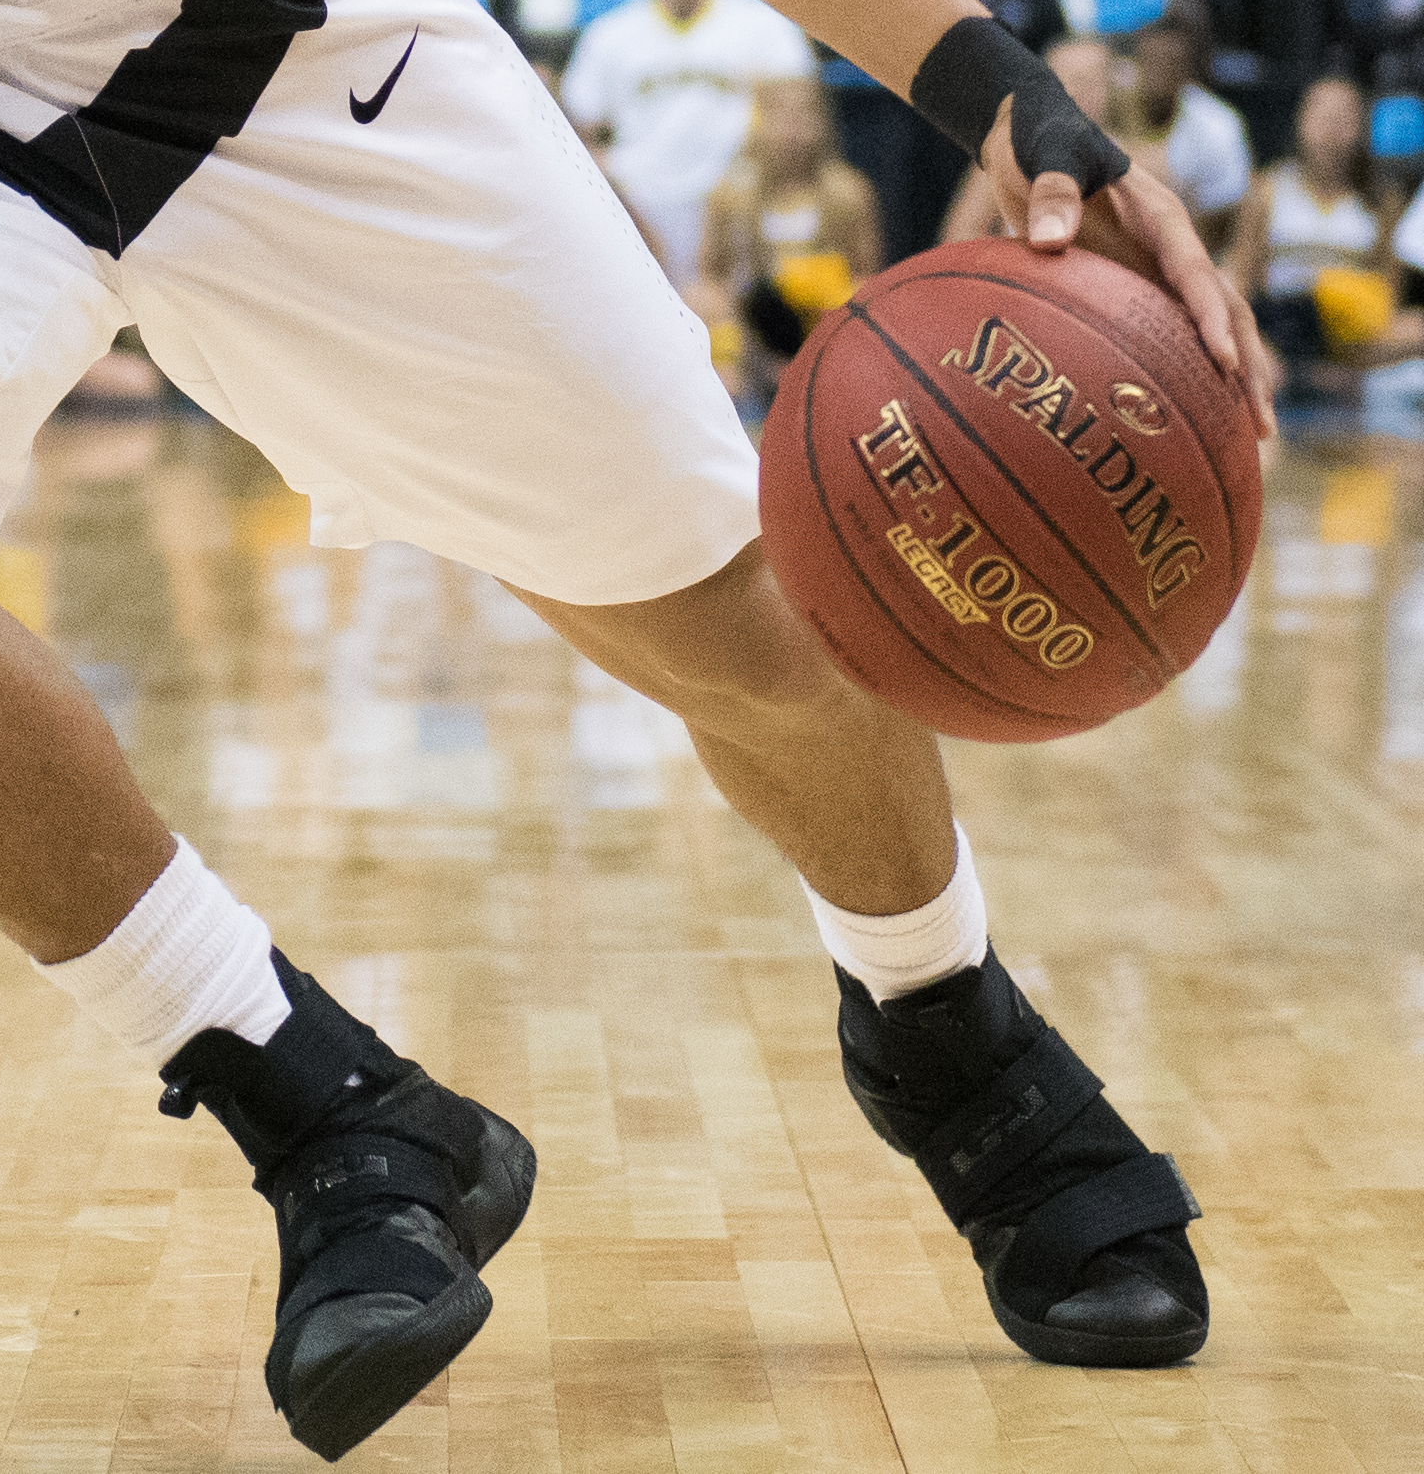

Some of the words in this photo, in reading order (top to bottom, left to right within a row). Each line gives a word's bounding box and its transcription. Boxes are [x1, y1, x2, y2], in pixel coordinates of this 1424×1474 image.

[858, 398, 1095, 670] TF-1000
[887, 523, 987, 624] LEGACY
[940, 316, 1208, 611] SPALDING
